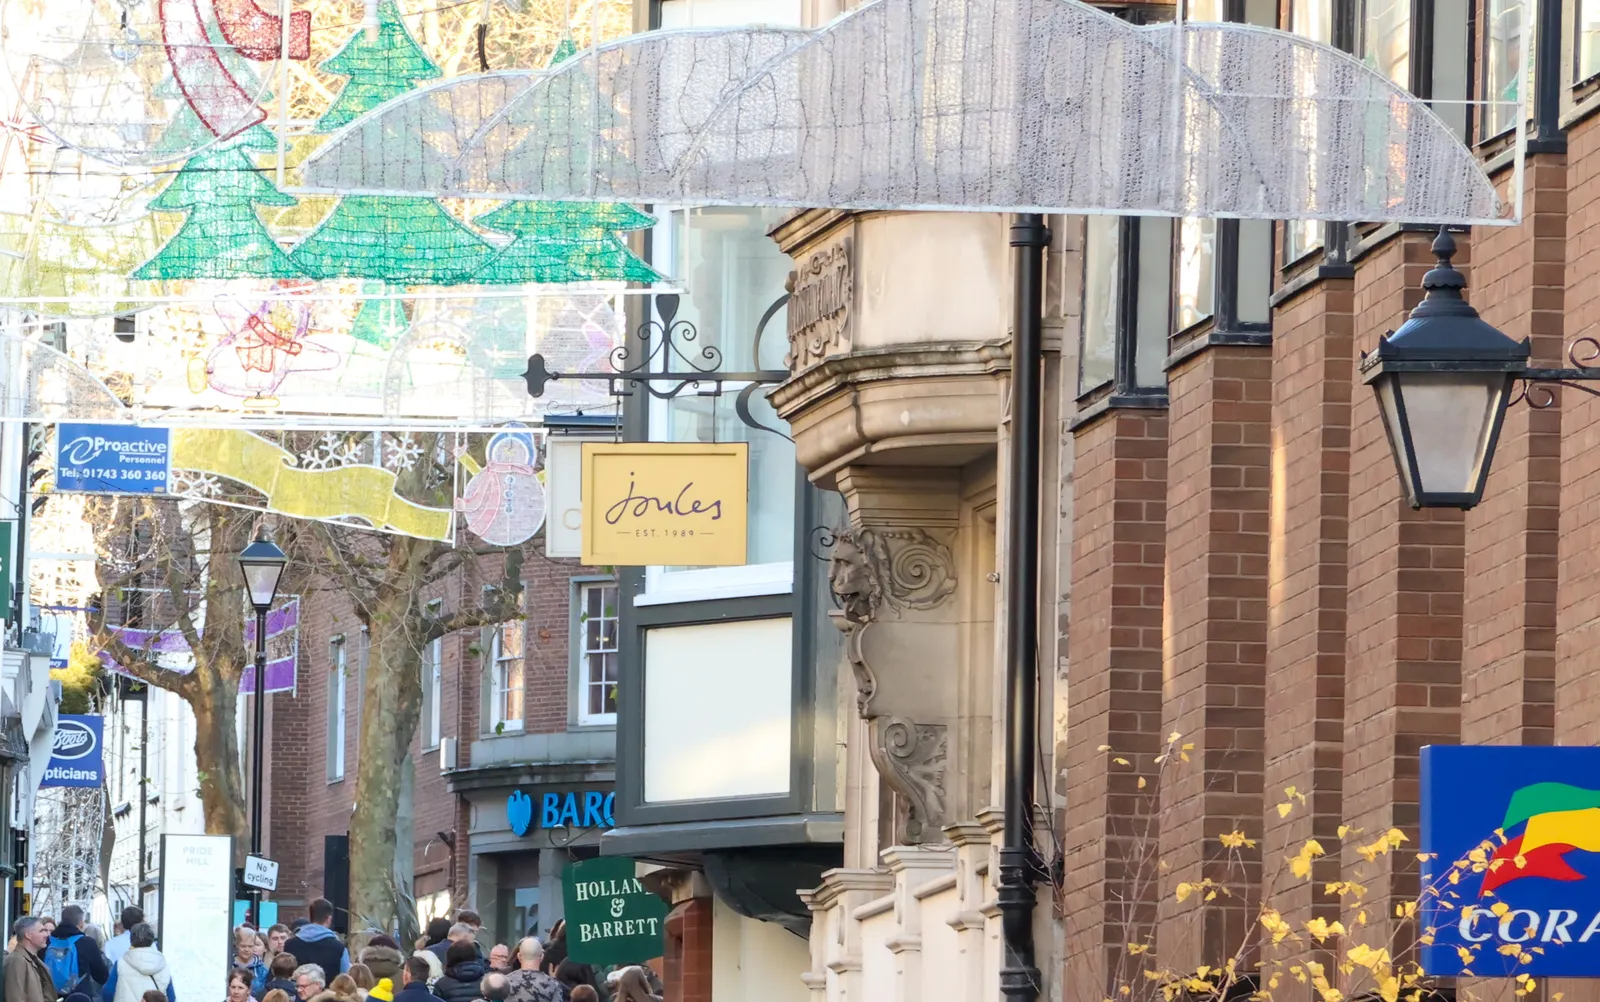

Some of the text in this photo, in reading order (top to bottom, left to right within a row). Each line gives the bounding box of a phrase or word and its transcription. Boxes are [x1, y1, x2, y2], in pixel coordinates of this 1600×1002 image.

[94, 437, 167, 453] Proactive
[119, 455, 165, 465] Personnel
[83, 468, 117, 479] 01743
[120, 469, 142, 480] 360
[144, 470, 166, 481] 360
[635, 529, 695, 538] EST. 1989
[45, 767, 98, 780] pticians
[182, 846, 213, 856] PRIDE
[186, 857, 210, 866] HILL
[256, 862, 268, 873] No
[247, 872, 274, 887] cycling
[575, 877, 654, 901] HOLLAN
[610, 898, 625, 918] &
[579, 917, 659, 943] BARRETT
[1458, 908, 1600, 943] CORA
